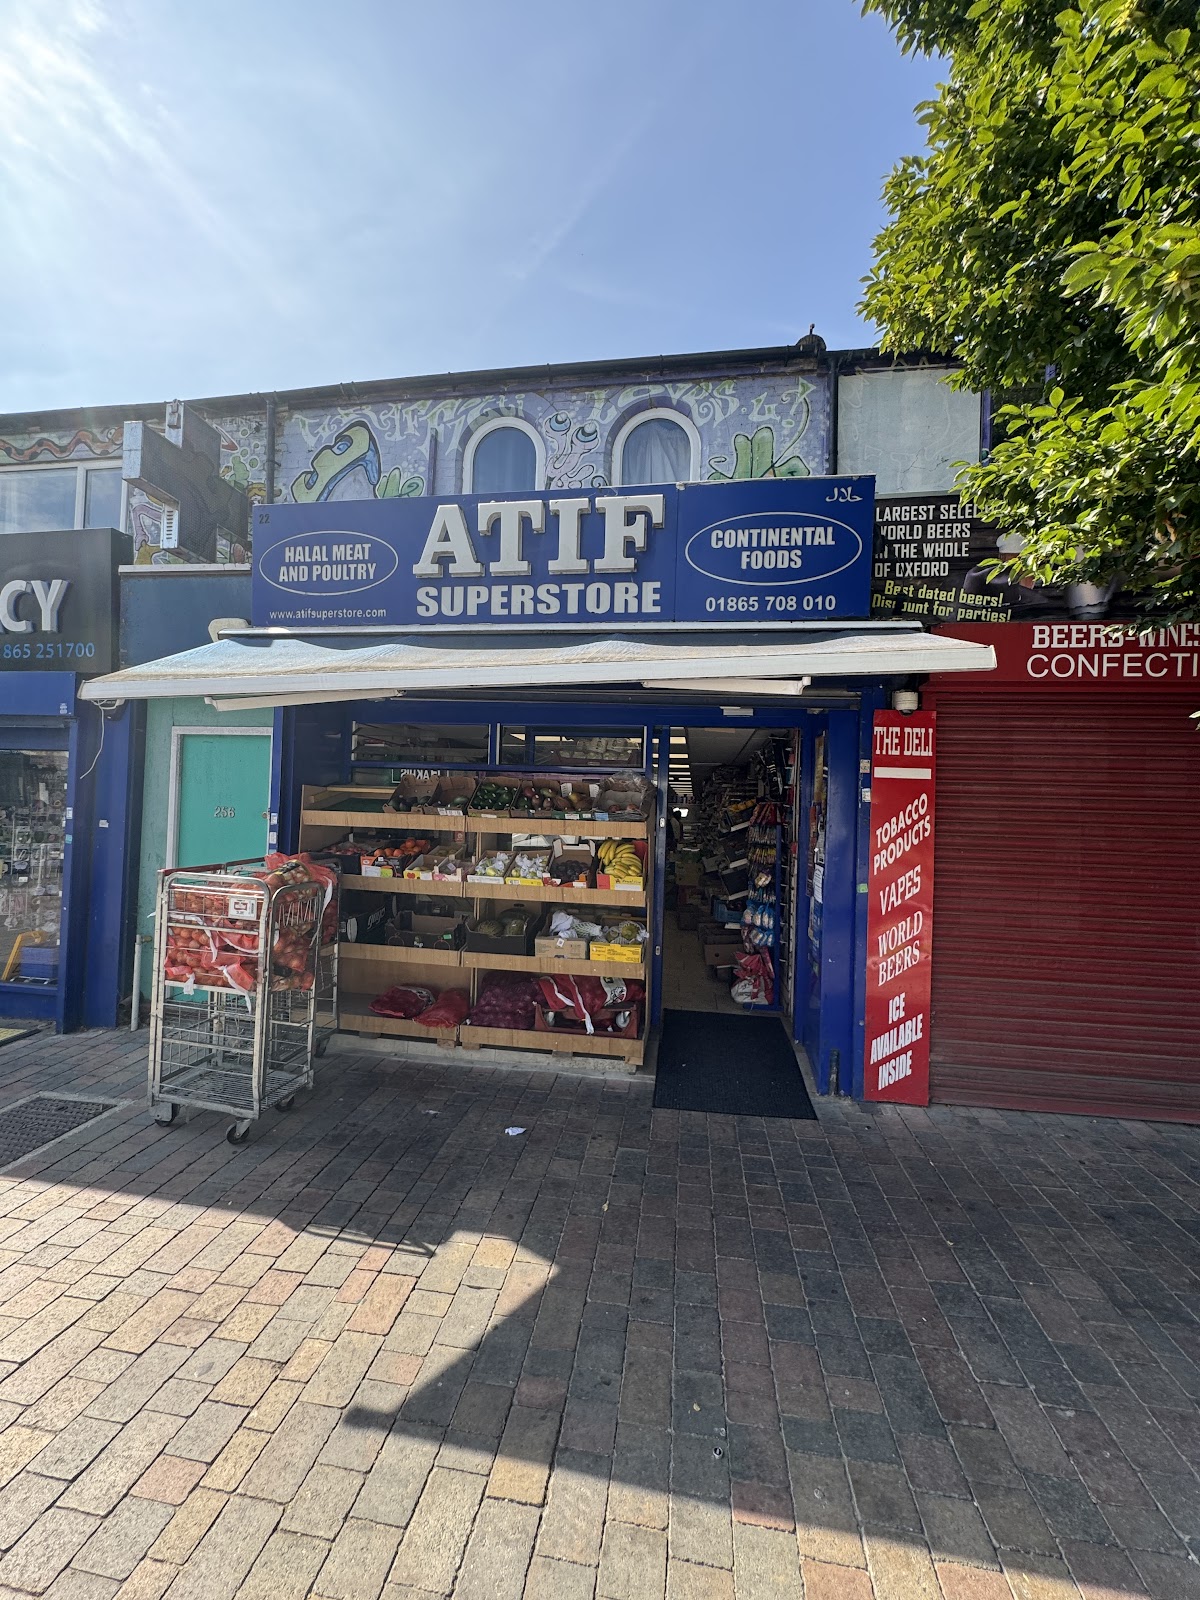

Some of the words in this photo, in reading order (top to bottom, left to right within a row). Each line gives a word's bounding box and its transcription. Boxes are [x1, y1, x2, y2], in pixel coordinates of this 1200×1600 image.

[825, 486, 863, 502] حلال
[258, 513, 270, 524] 22
[875, 505, 935, 522] LARGEST
[412, 494, 665, 578] ATIF
[710, 526, 835, 549] CONTINENTAL
[926, 522, 971, 539] BEERS
[285, 545, 328, 562] HALAL
[332, 543, 371, 561] MEAT
[740, 549, 802, 570] FOODS
[893, 543, 918, 559] THE
[922, 541, 970, 557] WHOLE
[278, 565, 309, 582] AND
[312, 562, 377, 581] POULTRY
[874, 562, 891, 578] OF
[895, 561, 949, 577] OXFORD
[416, 581, 661, 617] SUPERSTORE
[705, 596, 758, 612] 01865
[764, 595, 797, 611] 708
[802, 594, 836, 610] 010
[884, 579, 914, 597] Best
[918, 583, 955, 602] dated
[958, 588, 1004, 608] beers!
[269, 607, 387, 620] www.atifsuperstore.com
[932, 600, 953, 617] for
[956, 607, 1012, 622] parties!
[36, 642, 95, 658] 251700
[1026, 652, 1198, 678] CONFECTI
[873, 727, 900, 756] THE
[903, 727, 933, 756] DELI
[214, 806, 236, 818] 256
[876, 793, 928, 848] TOBACCO
[873, 815, 931, 876] PRODUCTS
[879, 864, 921, 916] VAPES
[877, 910, 923, 958] WORLD
[878, 940, 920, 987] BEERS
[888, 992, 906, 1025] ICE
[870, 1013, 923, 1065] AVAILABLE
[877, 1050, 912, 1091] INSIDE
